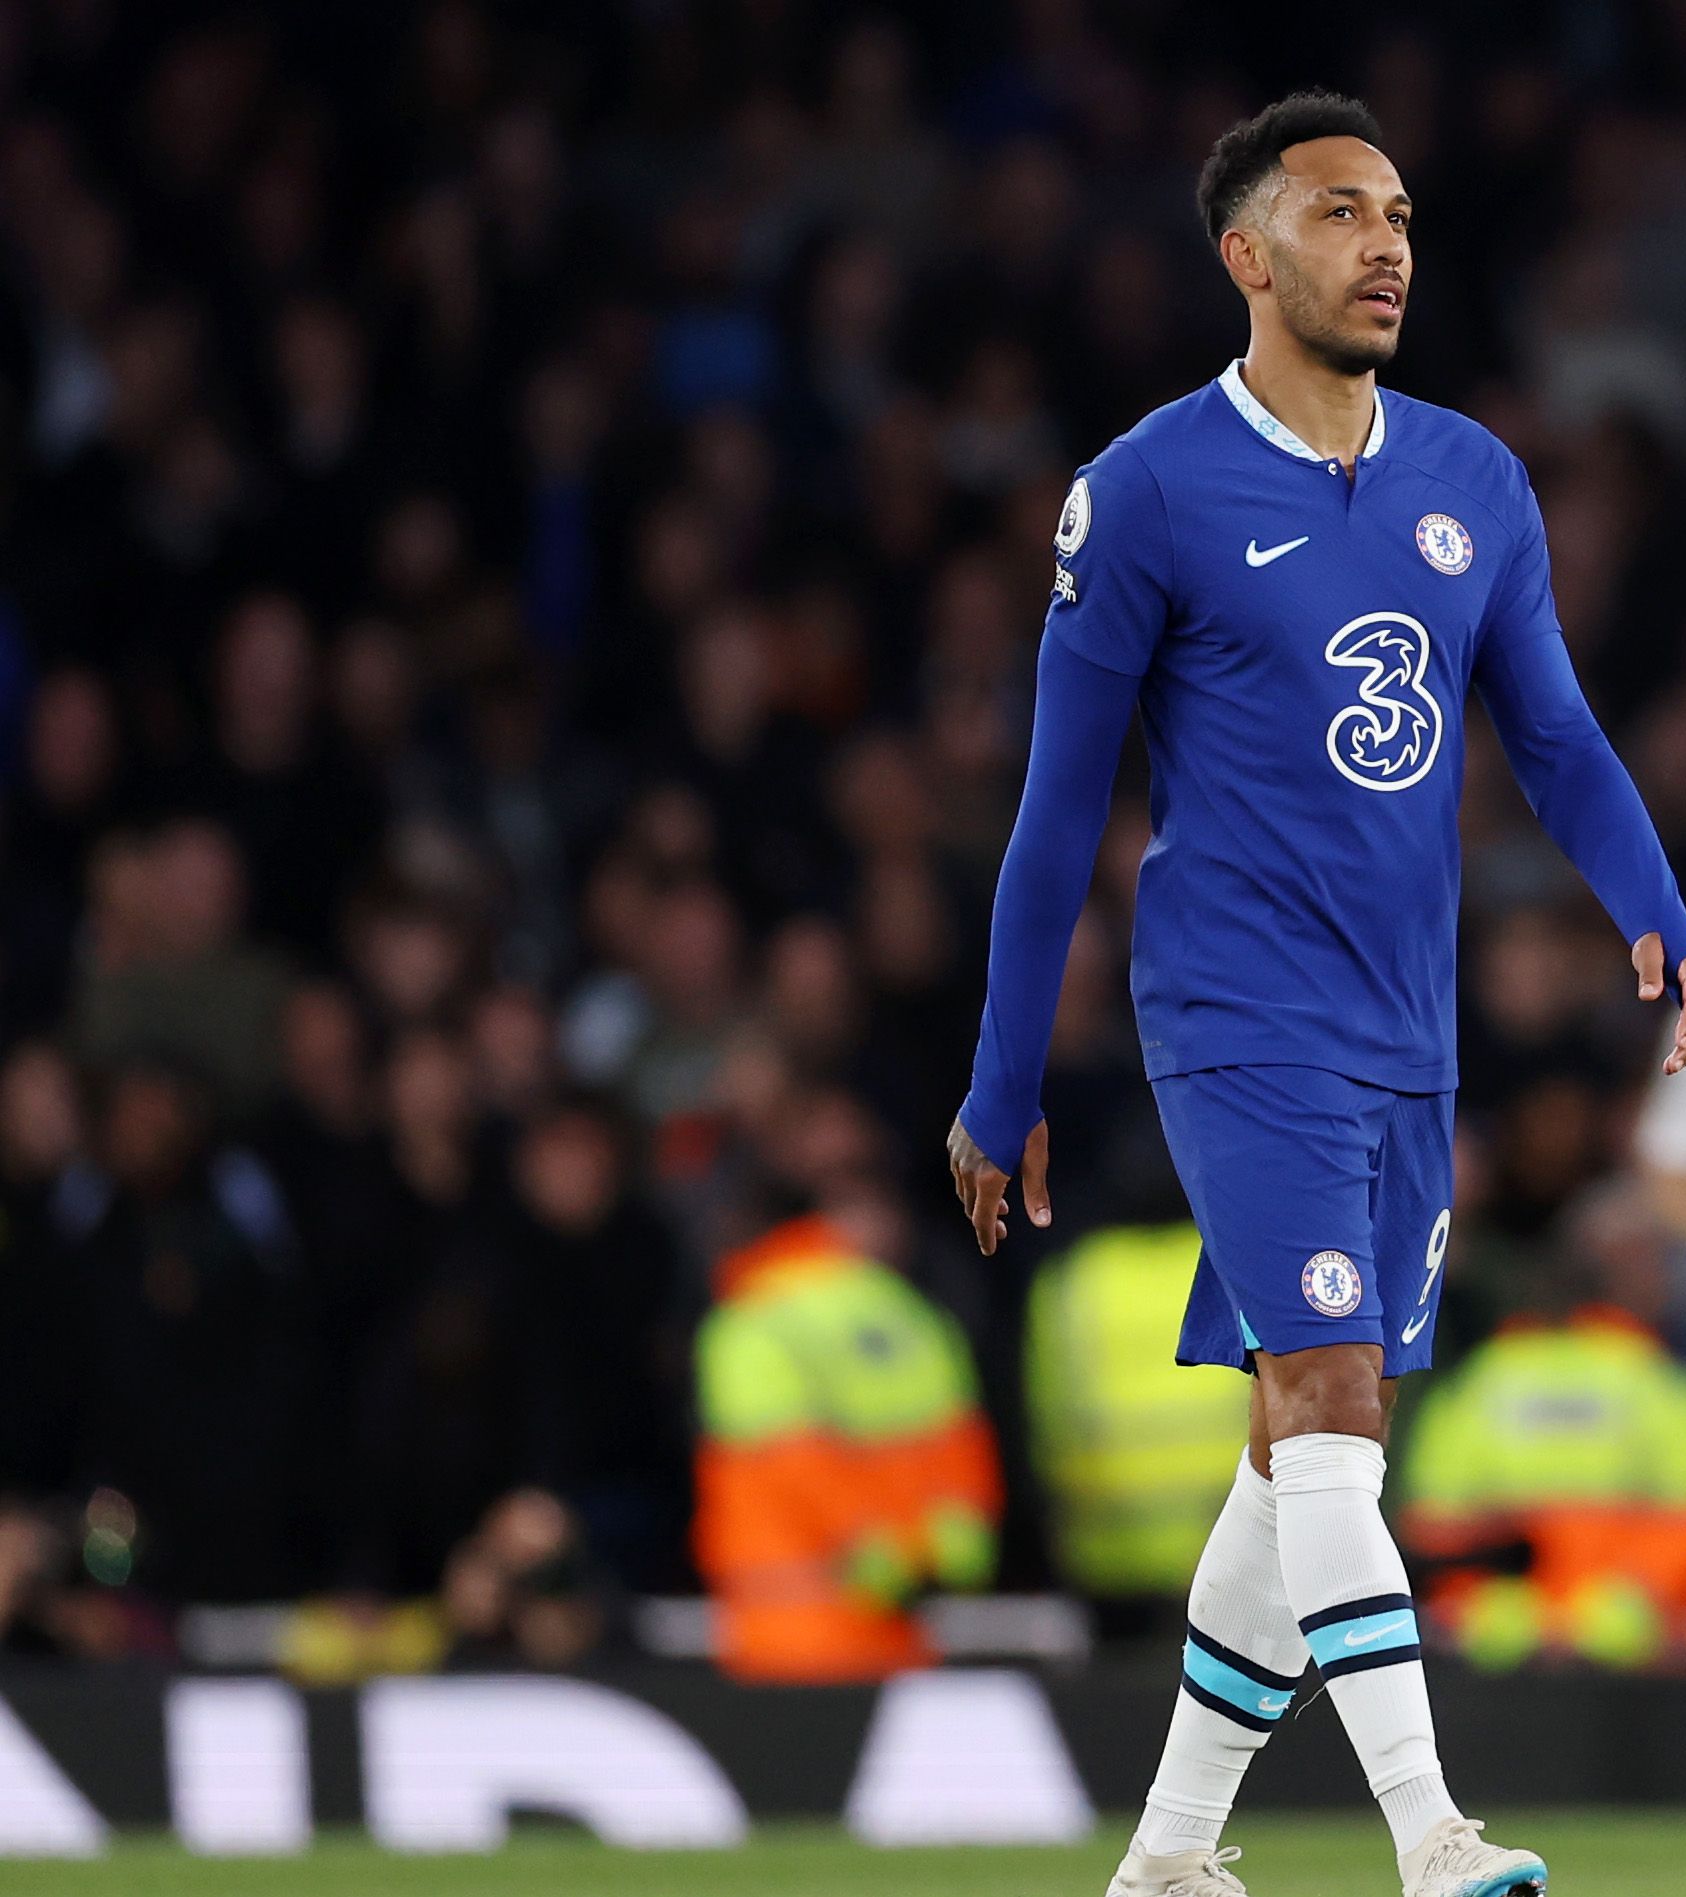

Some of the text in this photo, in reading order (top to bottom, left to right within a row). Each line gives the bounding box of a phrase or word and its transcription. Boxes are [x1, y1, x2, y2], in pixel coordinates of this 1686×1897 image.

[1325, 612, 1443, 792] 3
[1311, 1253, 1348, 1268] CHELSEA
[1418, 1208, 1451, 1306] 9
